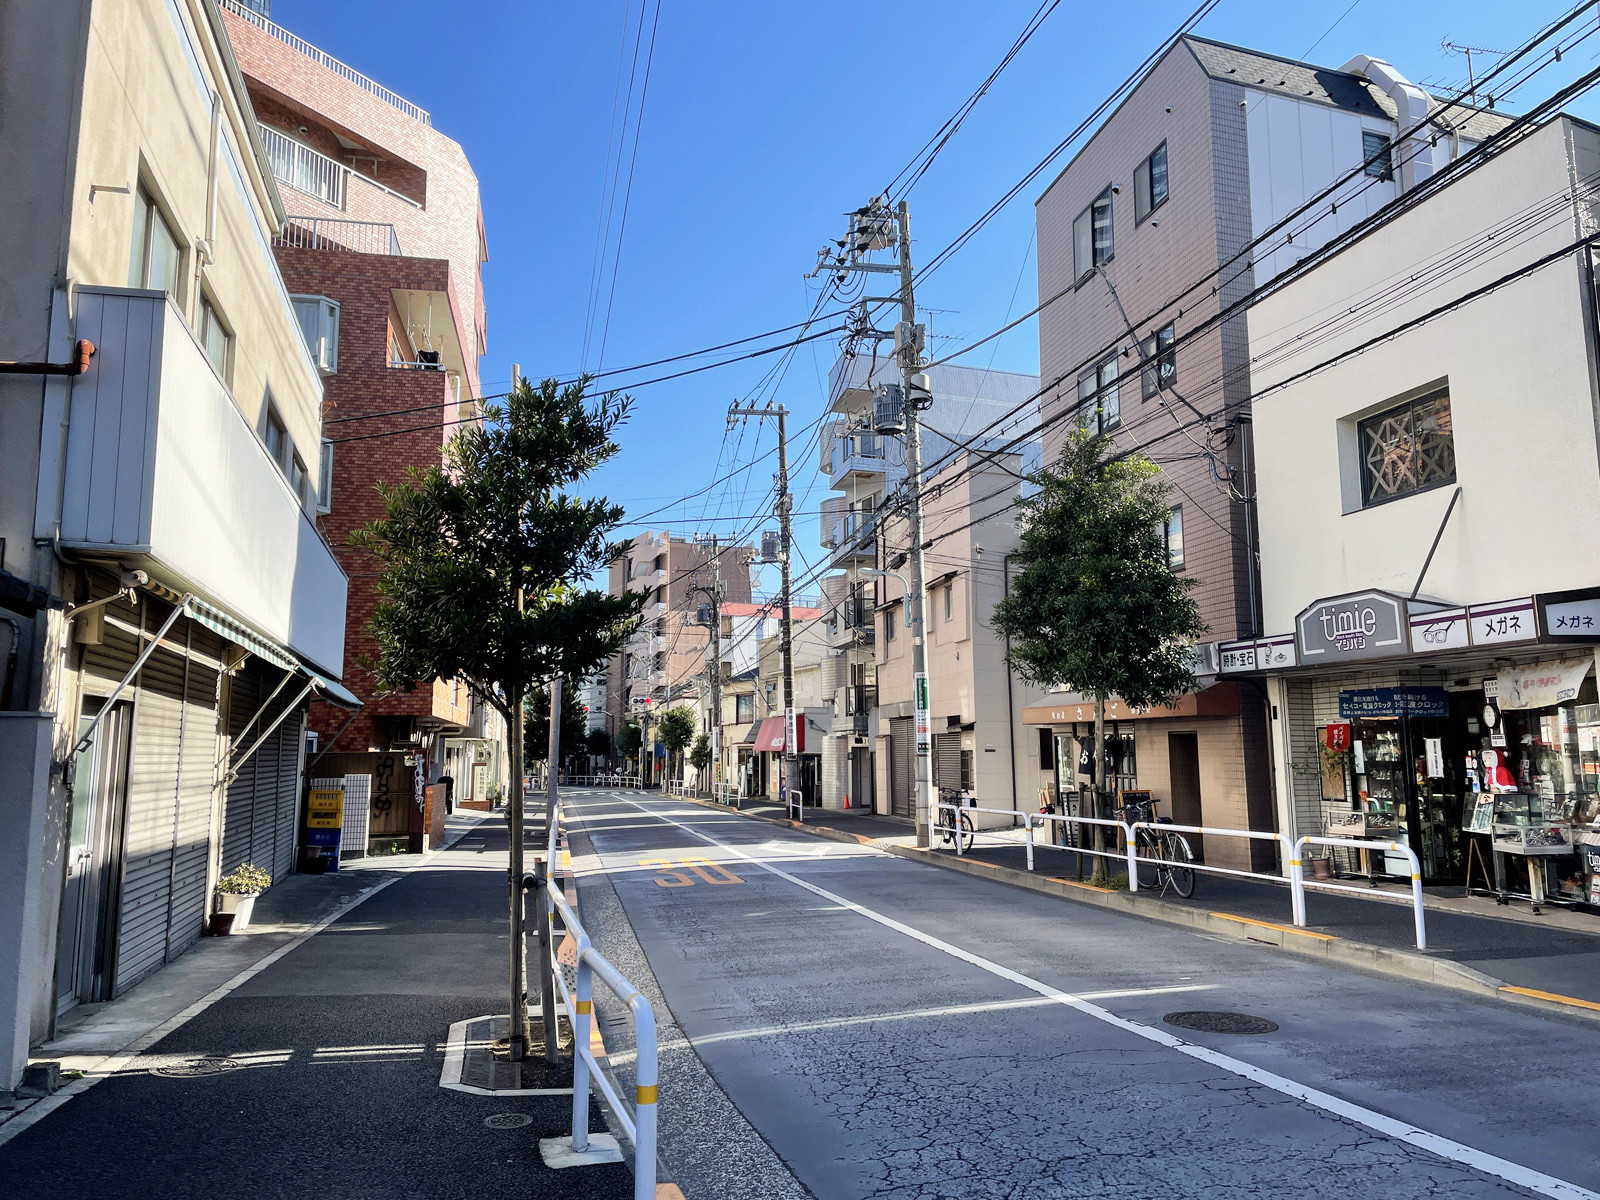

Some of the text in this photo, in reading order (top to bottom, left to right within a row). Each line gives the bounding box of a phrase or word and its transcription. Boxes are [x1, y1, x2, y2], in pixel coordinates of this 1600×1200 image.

[1319, 603, 1376, 641] timie
[1485, 614, 1522, 637] メガネ
[1556, 615, 1595, 629] メガネ
[1223, 651, 1254, 667] 時計・宝石
[638, 857, 747, 888] 30
